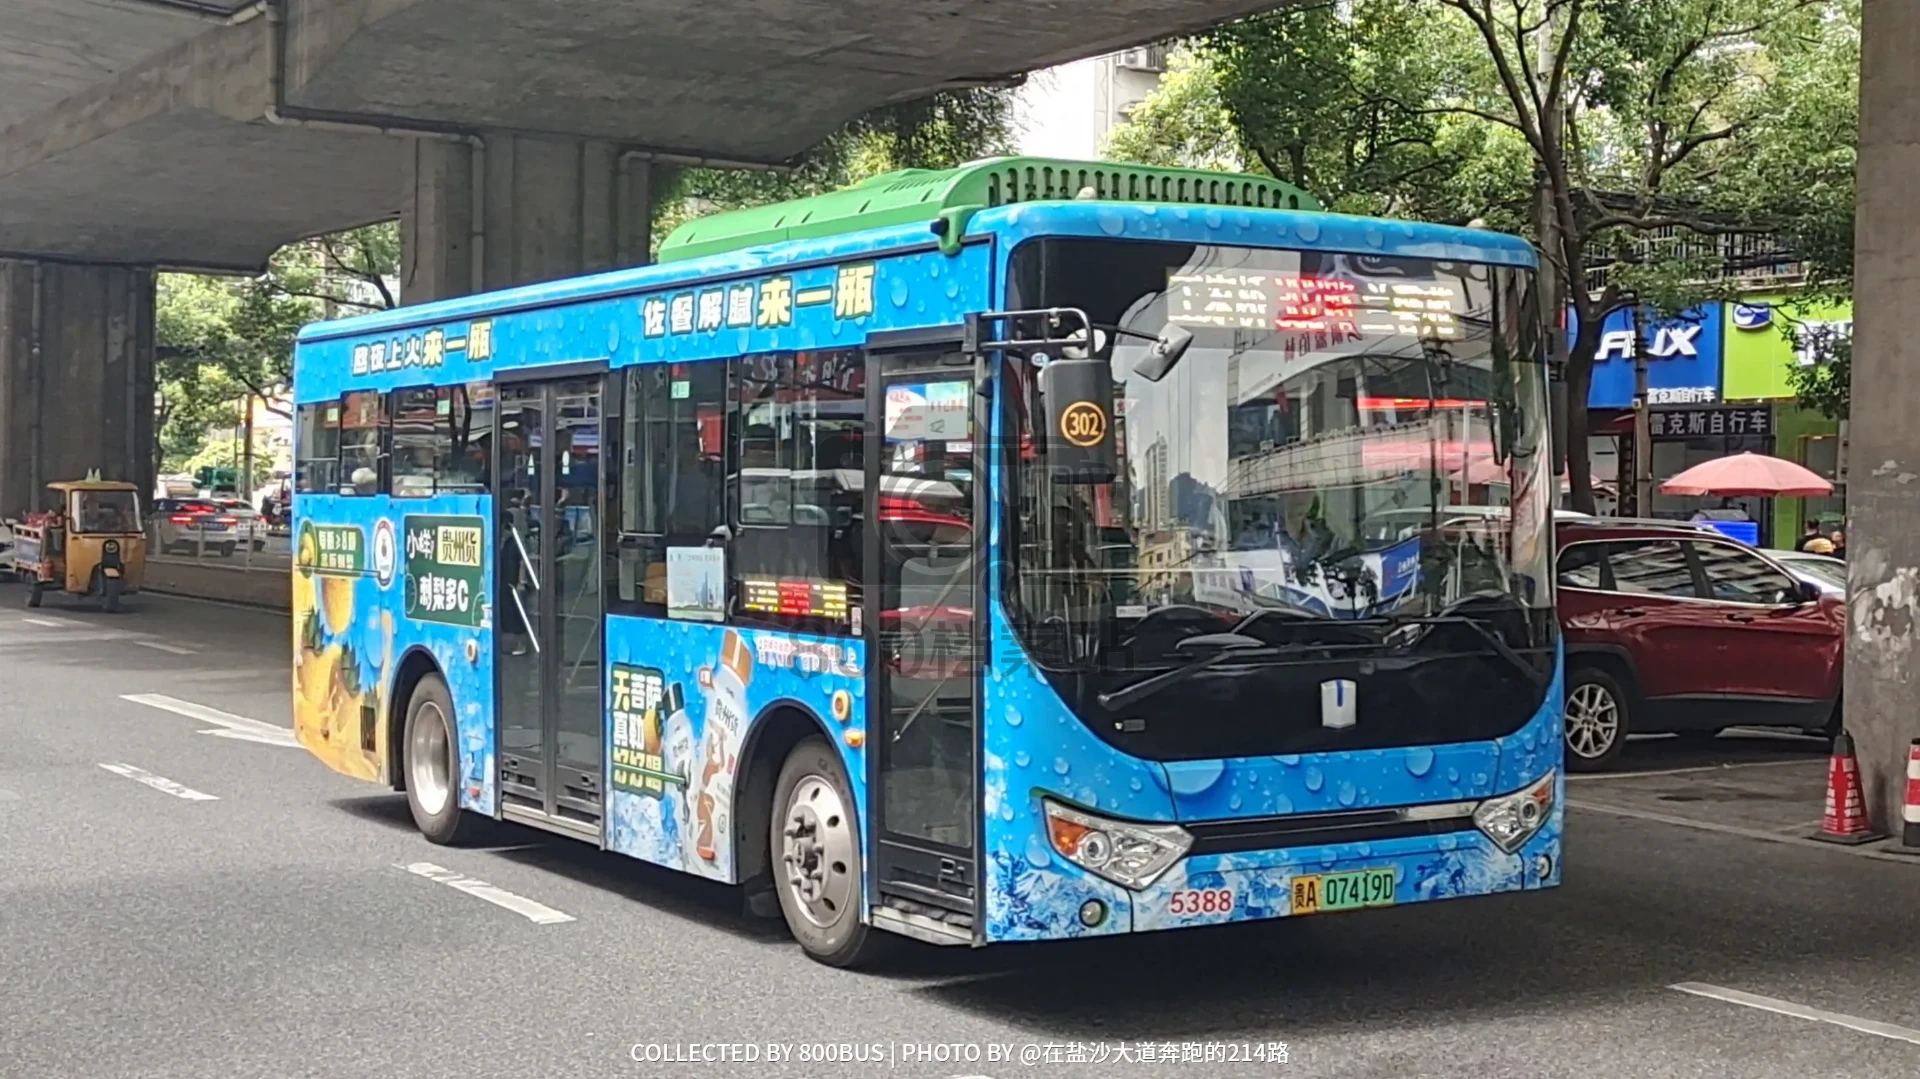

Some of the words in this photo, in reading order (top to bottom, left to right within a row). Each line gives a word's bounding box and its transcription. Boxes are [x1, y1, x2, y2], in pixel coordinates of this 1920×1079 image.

[1069, 411, 1100, 436] 302
[1649, 410, 1768, 436] 雷克斯自行车
[442, 529, 478, 565] 贵州货
[419, 572, 469, 613] 刺梨多C
[1170, 890, 1233, 914] 5388
[1294, 880, 1318, 910] 贵A
[1326, 873, 1394, 906] 07419D
